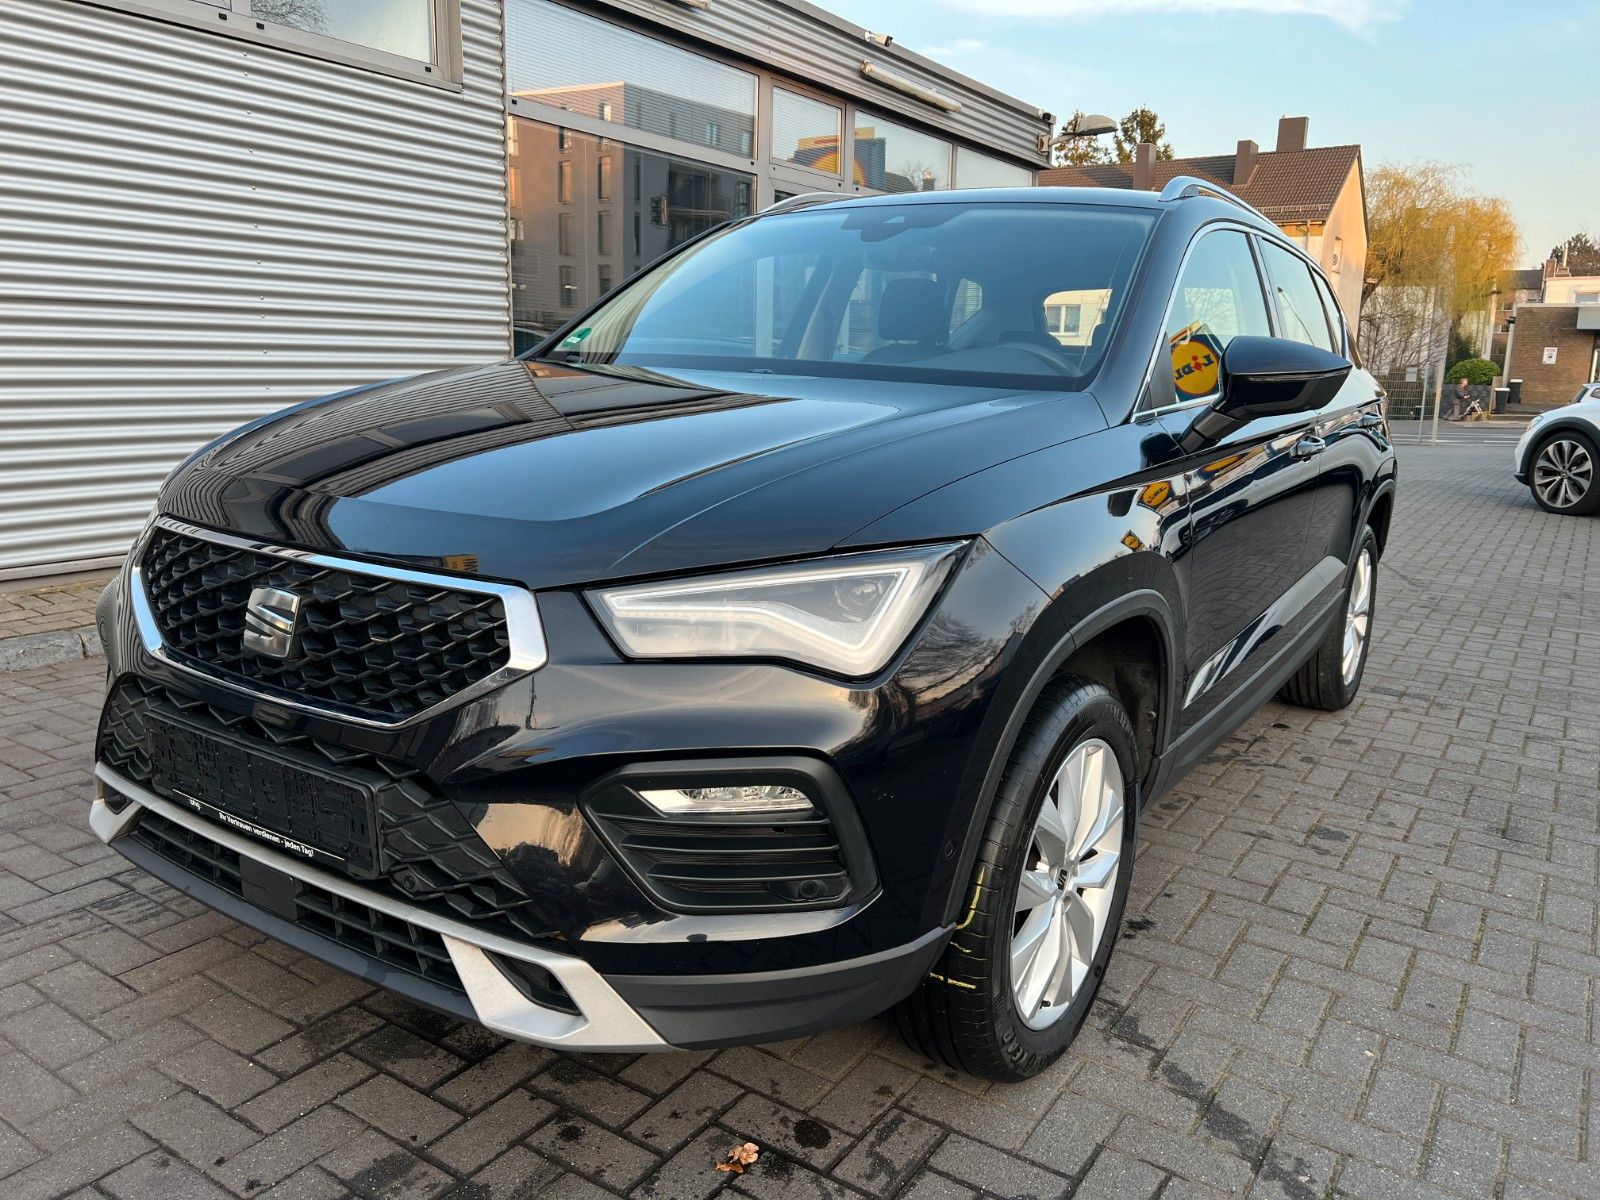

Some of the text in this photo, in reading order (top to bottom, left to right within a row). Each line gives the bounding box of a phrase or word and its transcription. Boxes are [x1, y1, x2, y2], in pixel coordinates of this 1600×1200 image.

[227, 815, 253, 832] Vertrauen
[253, 828, 280, 844] verdienen
[284, 839, 301, 852] jeden
